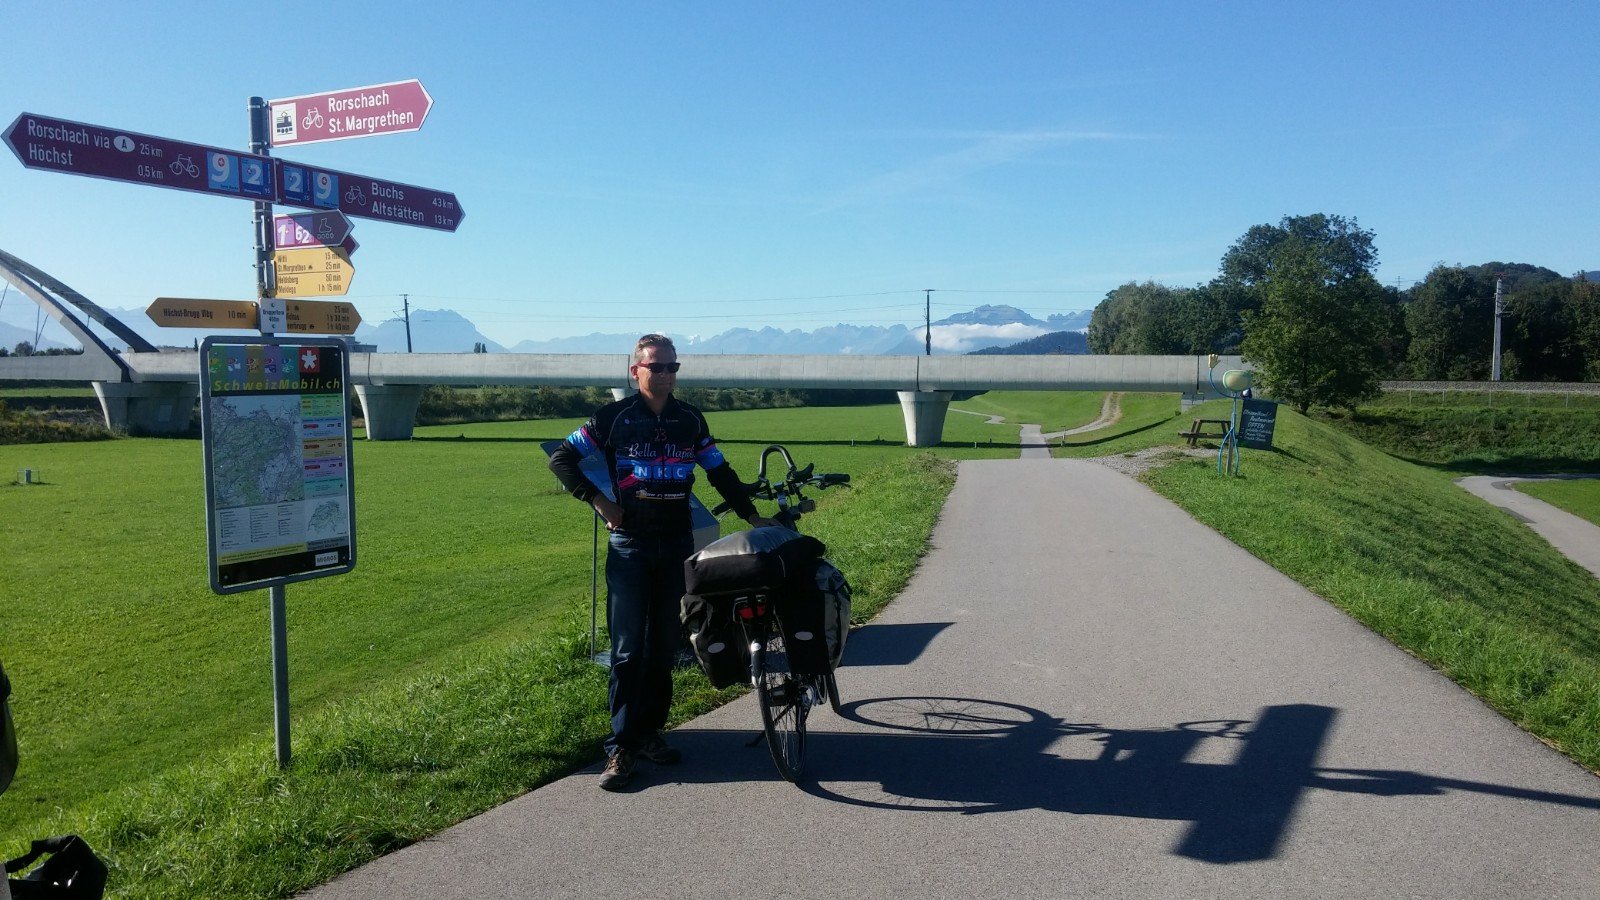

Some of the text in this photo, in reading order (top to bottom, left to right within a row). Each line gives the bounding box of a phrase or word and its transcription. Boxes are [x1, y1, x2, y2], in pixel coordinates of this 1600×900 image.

[328, 90, 389, 113] Rorschach
[328, 110, 414, 134] St.Margrethen
[27, 119, 128, 149] Rorschach via A
[29, 143, 73, 166] Höchst
[140, 143, 163, 159] 25 km
[211, 153, 230, 183] 9
[247, 164, 263, 186] 2
[289, 172, 303, 193] 2
[316, 172, 332, 200] 9
[371, 182, 405, 200] Buchs
[371, 200, 425, 222] Altstätten
[295, 226, 310, 244] 62
[325, 252, 331, 260] 15
[326, 262, 332, 270] 25
[326, 274, 332, 282] 50
[333, 284, 341, 292] min
[228, 310, 246, 319] 10 min
[214, 377, 340, 391] SchweizMobil.ch
[628, 442, 657, 458] Bella
